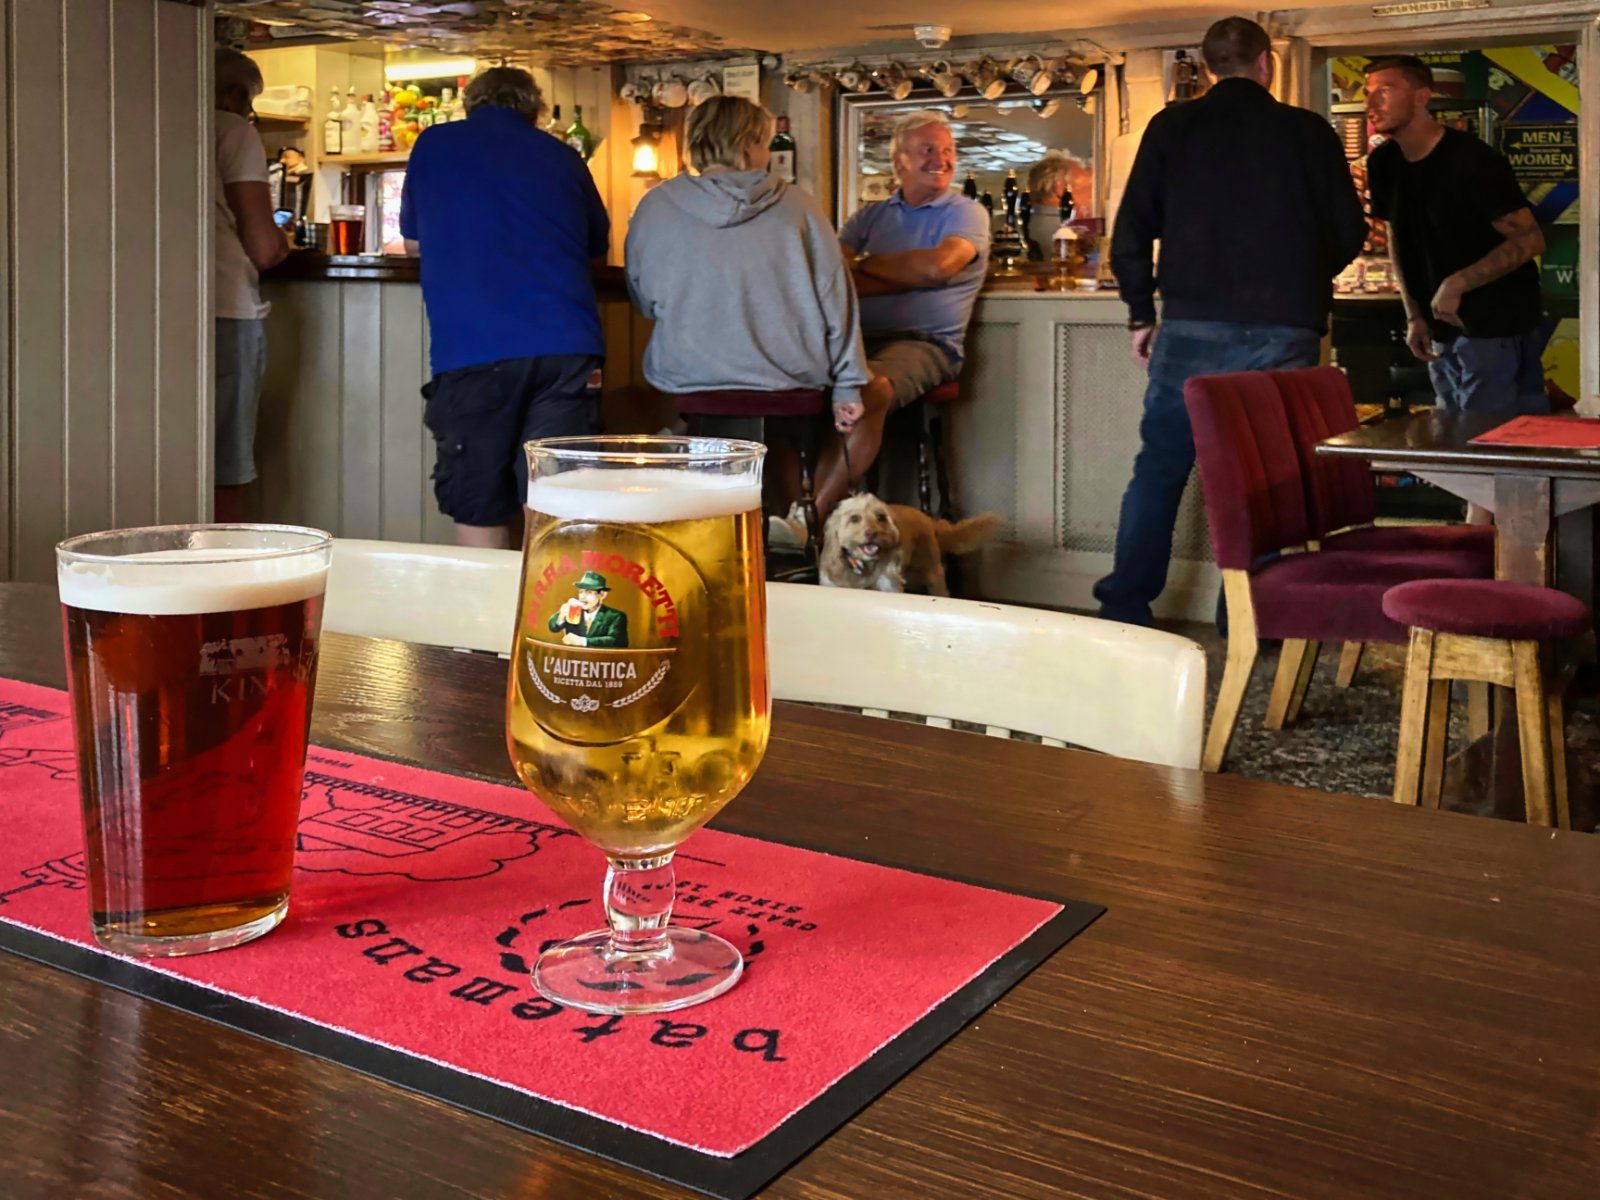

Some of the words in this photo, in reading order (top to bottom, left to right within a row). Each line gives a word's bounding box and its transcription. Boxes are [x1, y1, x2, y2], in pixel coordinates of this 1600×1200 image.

[1522, 131, 1560, 143] MEN
[1508, 153, 1573, 165] WOMEN
[581, 550, 680, 638] MORETTI
[543, 656, 637, 680] L'AUTENTICA
[553, 676, 585, 688] RICETTA
[586, 679, 603, 688] DAL
[334, 918, 787, 1062] batemans
